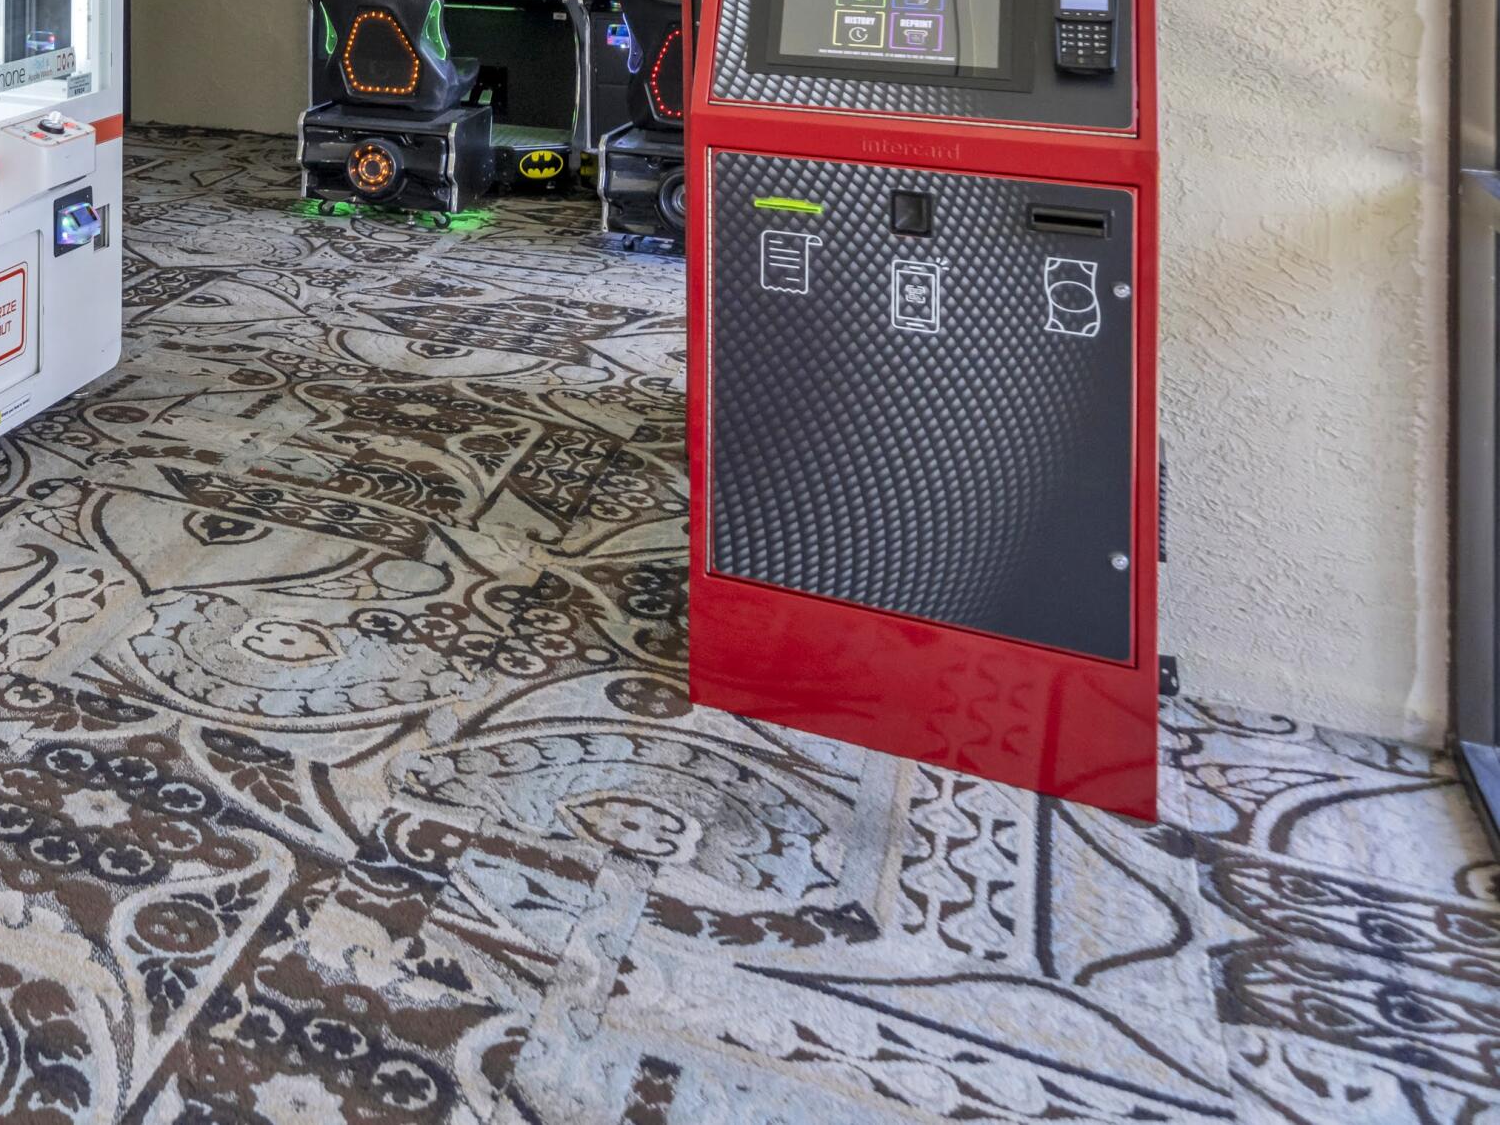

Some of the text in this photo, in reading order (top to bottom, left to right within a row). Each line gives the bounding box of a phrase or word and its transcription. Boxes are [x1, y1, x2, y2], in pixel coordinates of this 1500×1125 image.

[844, 16, 876, 26] HISTORY
[900, 18, 933, 28] REPRINT
[862, 137, 960, 160] intercard
